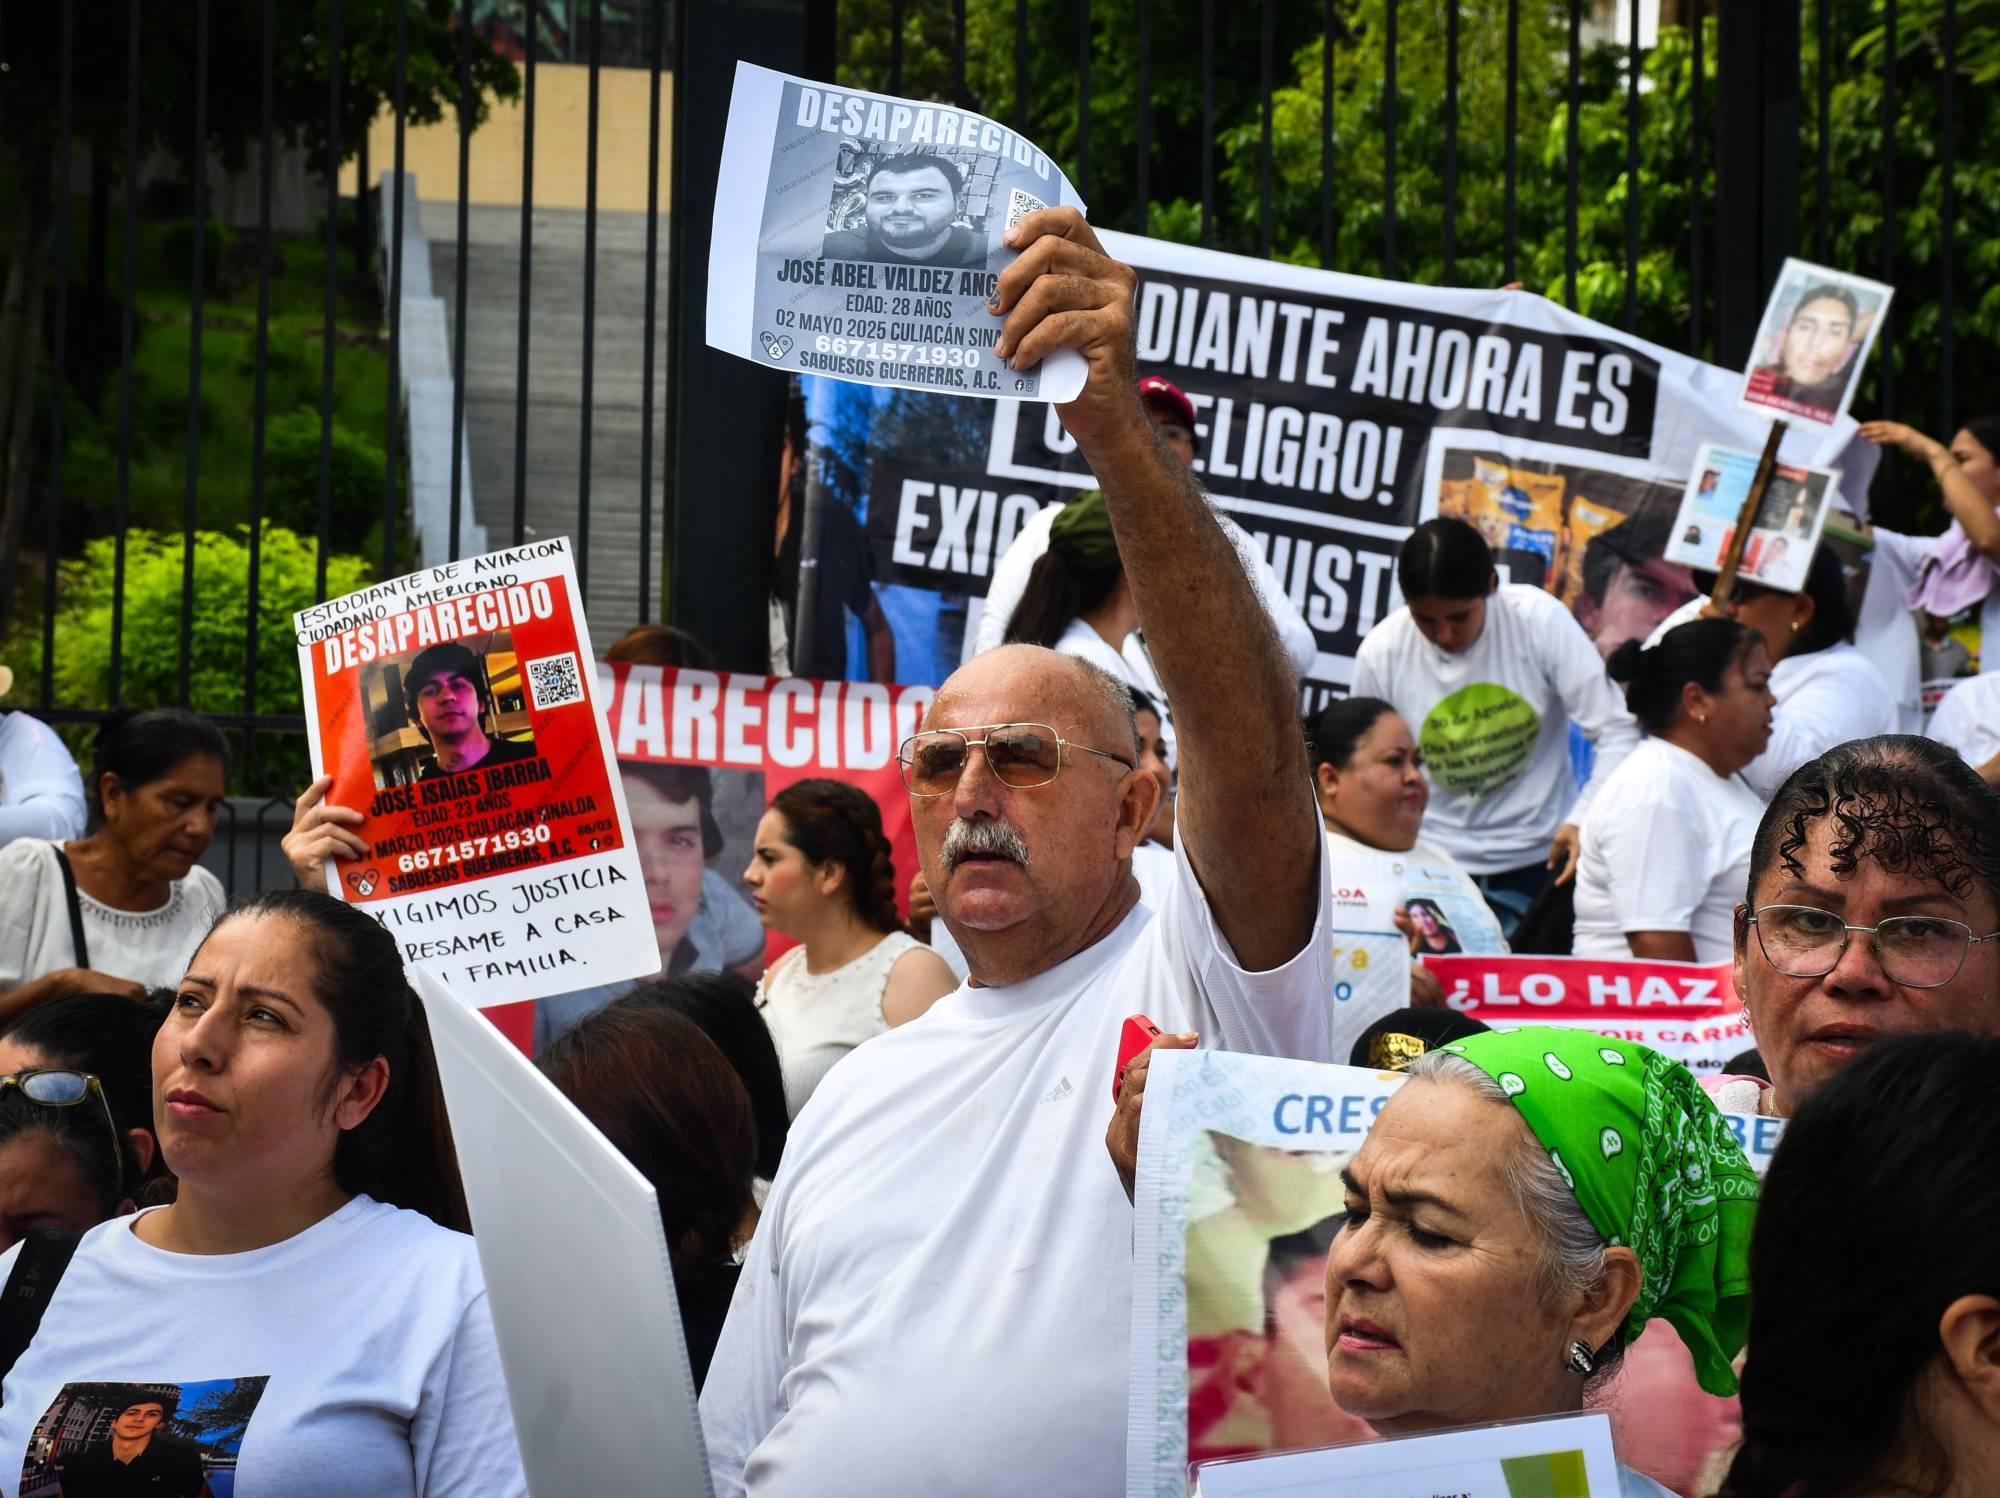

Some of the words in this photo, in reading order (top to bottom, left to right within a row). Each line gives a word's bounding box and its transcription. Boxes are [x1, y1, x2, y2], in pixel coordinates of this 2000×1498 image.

[796, 87, 1050, 181] DESAPARECIDO
[777, 256, 825, 285] JOSÉ
[831, 262, 877, 289] ABEL
[885, 266, 954, 295] VALDEZ
[846, 293, 888, 315] EDAD:
[891, 297, 910, 316] 28
[914, 296, 952, 319] AÑOS
[775, 309, 795, 328] 02
[799, 313, 843, 335] MAYO
[847, 319, 886, 340] 2025
[890, 322, 965, 345] CULIACÁN
[799, 350, 875, 378] SABUESOS
[879, 361, 968, 390] GUERRERAS,
[972, 369, 1001, 390] A.C.
[815, 335, 980, 368] 6671571930
[1136, 281, 1345, 389] DIANTE
[1350, 316, 1543, 421] AHORA
[1555, 350, 1632, 435] ES
[433, 564, 460, 583] DE
[474, 540, 565, 574] AVIACION
[296, 604, 387, 648] CIUDADANO
[405, 574, 519, 611] AMERICANO
[324, 581, 554, 676] DESAPARECIDO
[483, 758, 552, 792] IBARRA
[374, 832, 425, 858] MARZO
[427, 824, 465, 848] 2025
[466, 808, 535, 838] CULIACÁN
[536, 795, 597, 823] SINALOA
[412, 805, 451, 828] EDAD:
[455, 801, 472, 818] 23
[388, 863, 459, 893] SABUESOS
[549, 838, 577, 859] A.C.
[398, 824, 551, 873] 6671571930
[512, 865, 627, 914] JUSTICIA
[527, 923, 542, 941] A
[554, 907, 625, 934] CASA
[1446, 973, 1566, 1011] ¿LO
[1588, 975, 1723, 1007] HAZ
[1657, 1024, 1754, 1044] CARR
